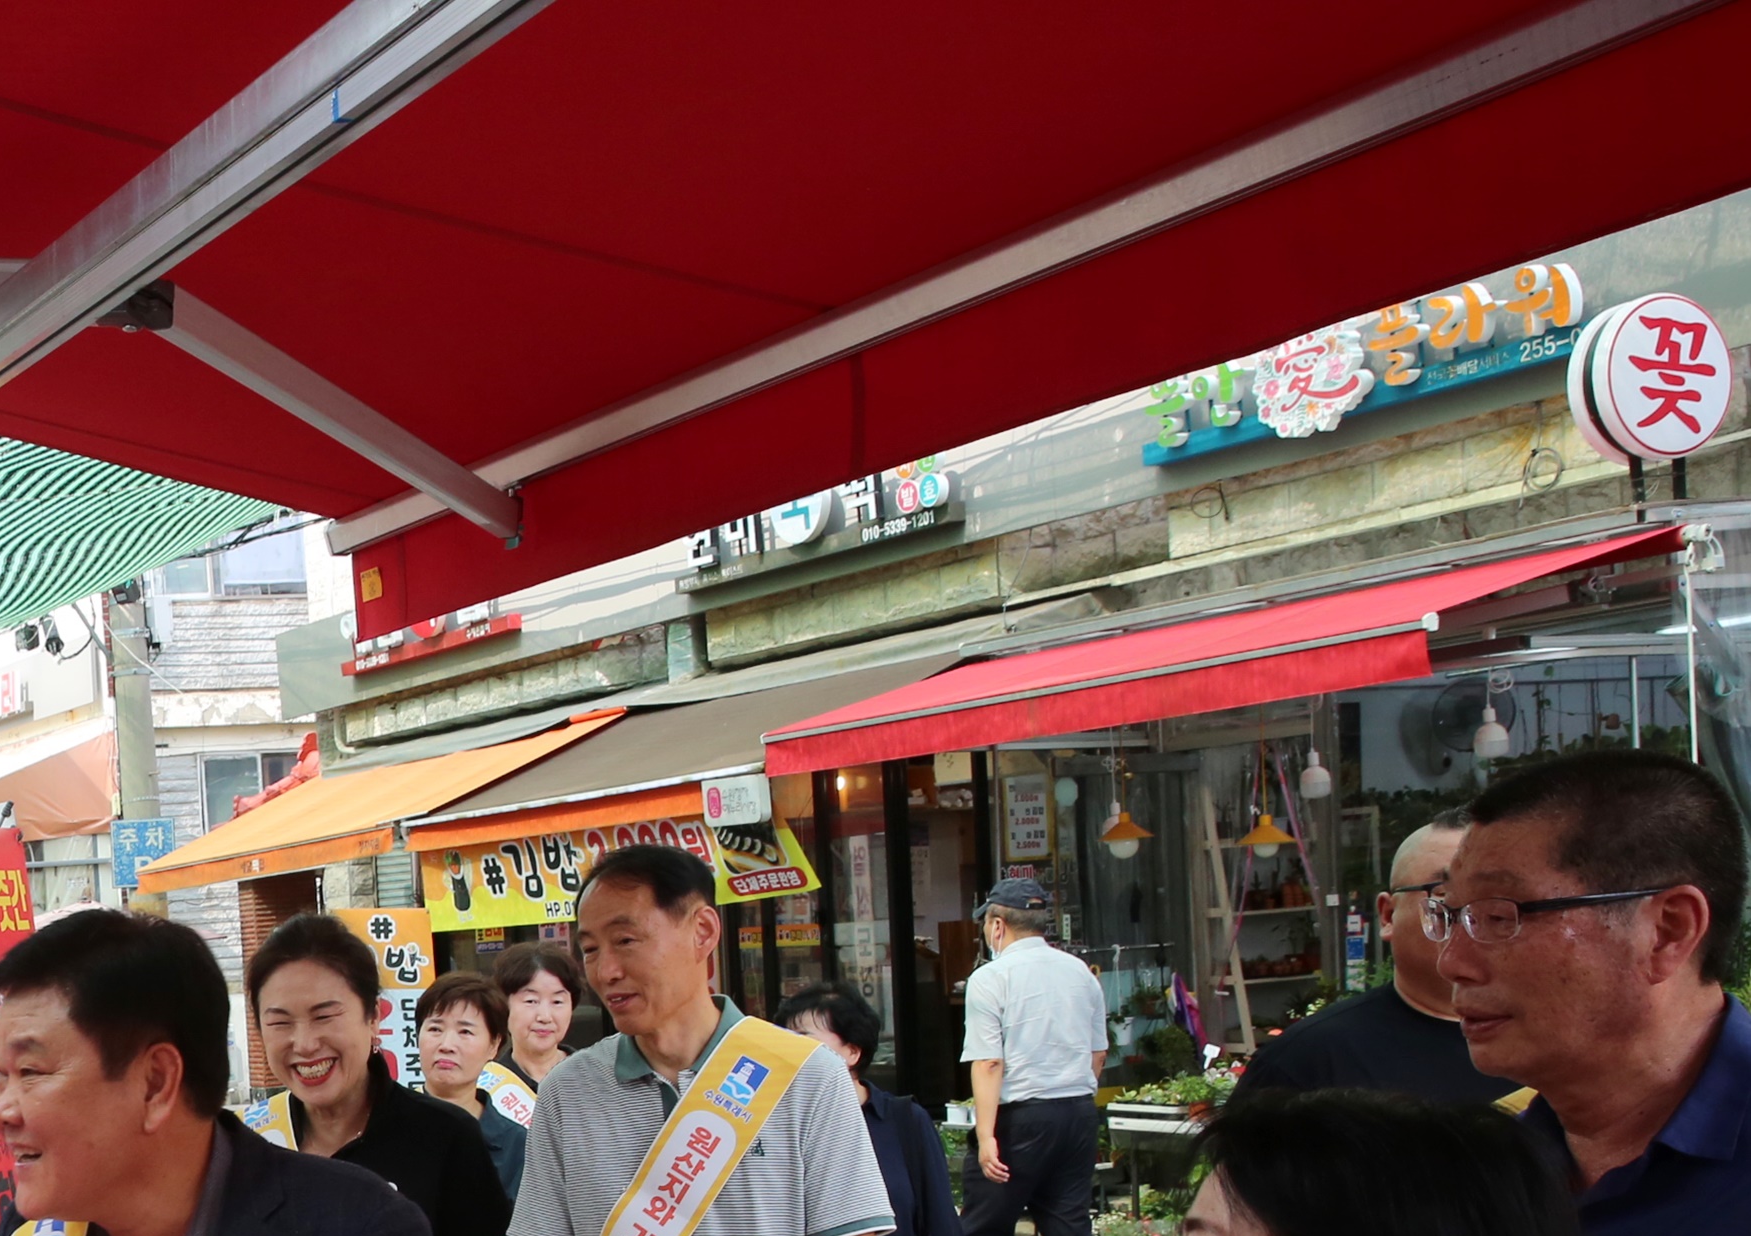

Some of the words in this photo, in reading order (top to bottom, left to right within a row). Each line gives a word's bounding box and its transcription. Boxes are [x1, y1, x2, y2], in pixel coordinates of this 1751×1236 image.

[1368, 263, 1580, 386] 플라워
[1519, 327, 1582, 364] 255-0
[1629, 314, 1716, 434] 꽃
[861, 511, 935, 542] 010-5339-1201
[118, 826, 165, 852] 주차
[733, 870, 802, 894] 단체주문환영
[702, 1088, 754, 1125] 수원특례시
[640, 1125, 723, 1228] 원산지와
